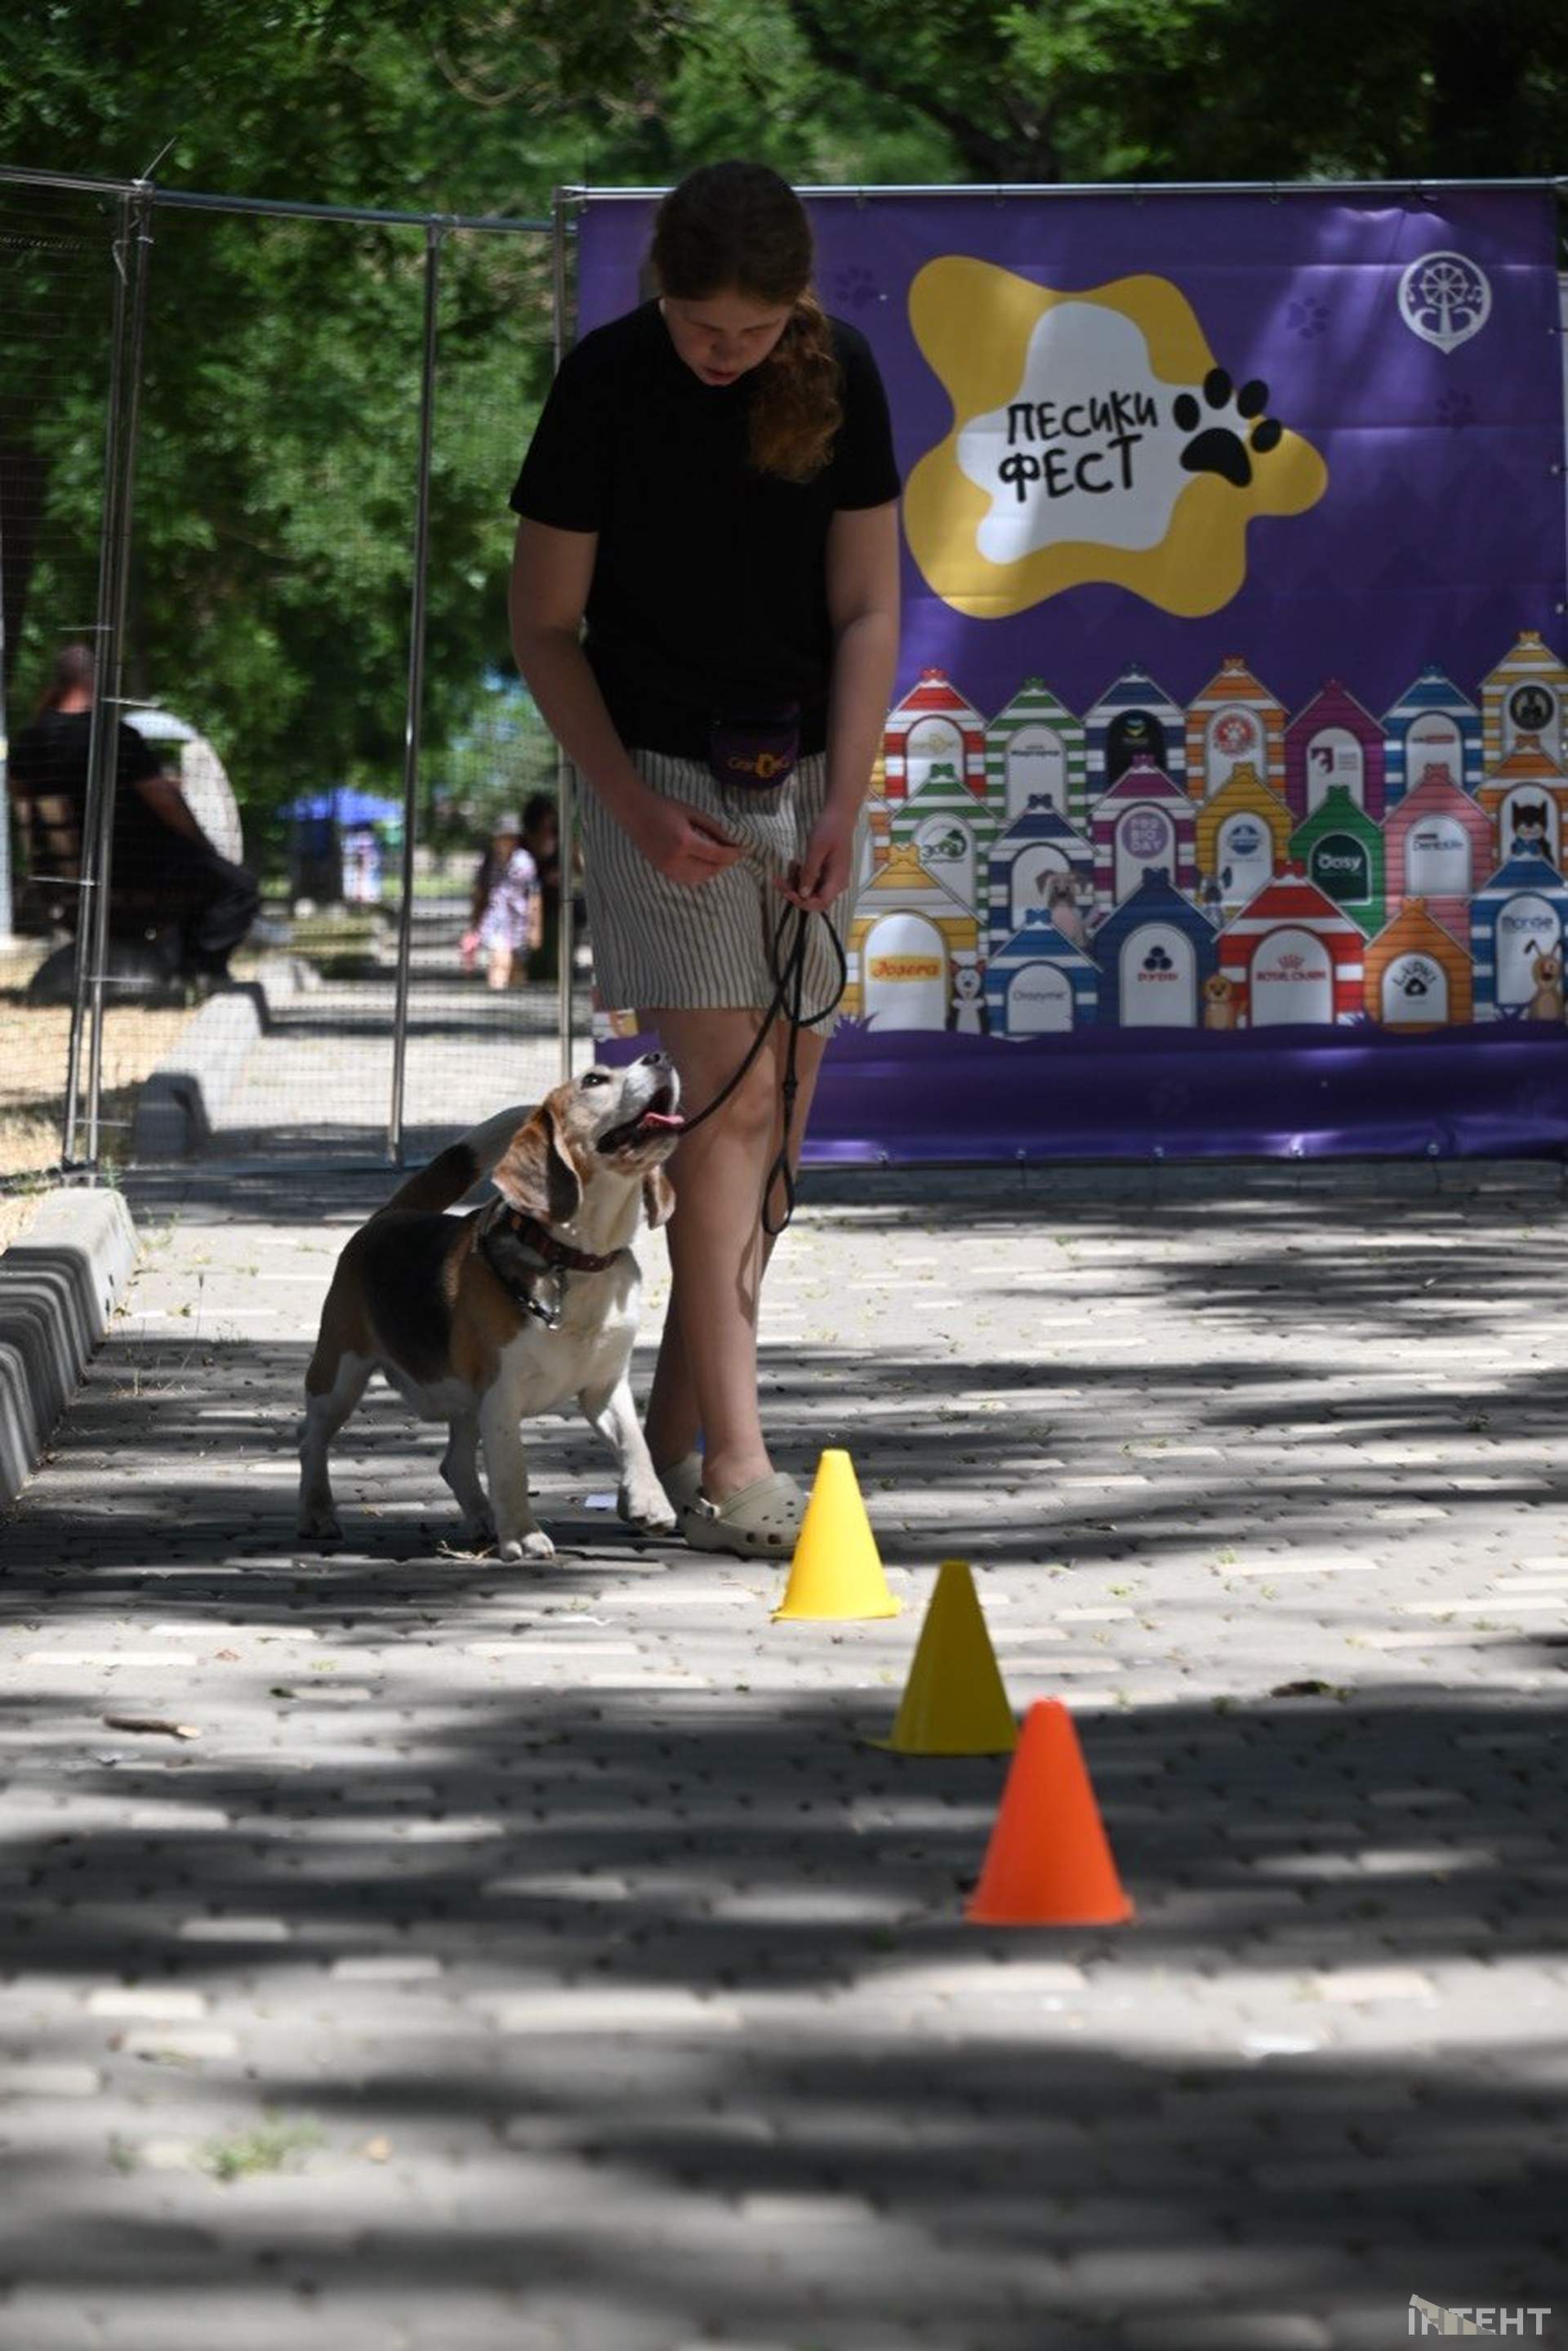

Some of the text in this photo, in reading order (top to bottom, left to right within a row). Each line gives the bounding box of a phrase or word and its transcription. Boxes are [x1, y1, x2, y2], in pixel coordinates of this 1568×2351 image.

[1006, 390, 1158, 445] ПЕСИКИ
[998, 435, 1143, 503] ФЕСТ
[1130, 841, 1162, 851] DAY
[1318, 854, 1362, 872] Oasy
